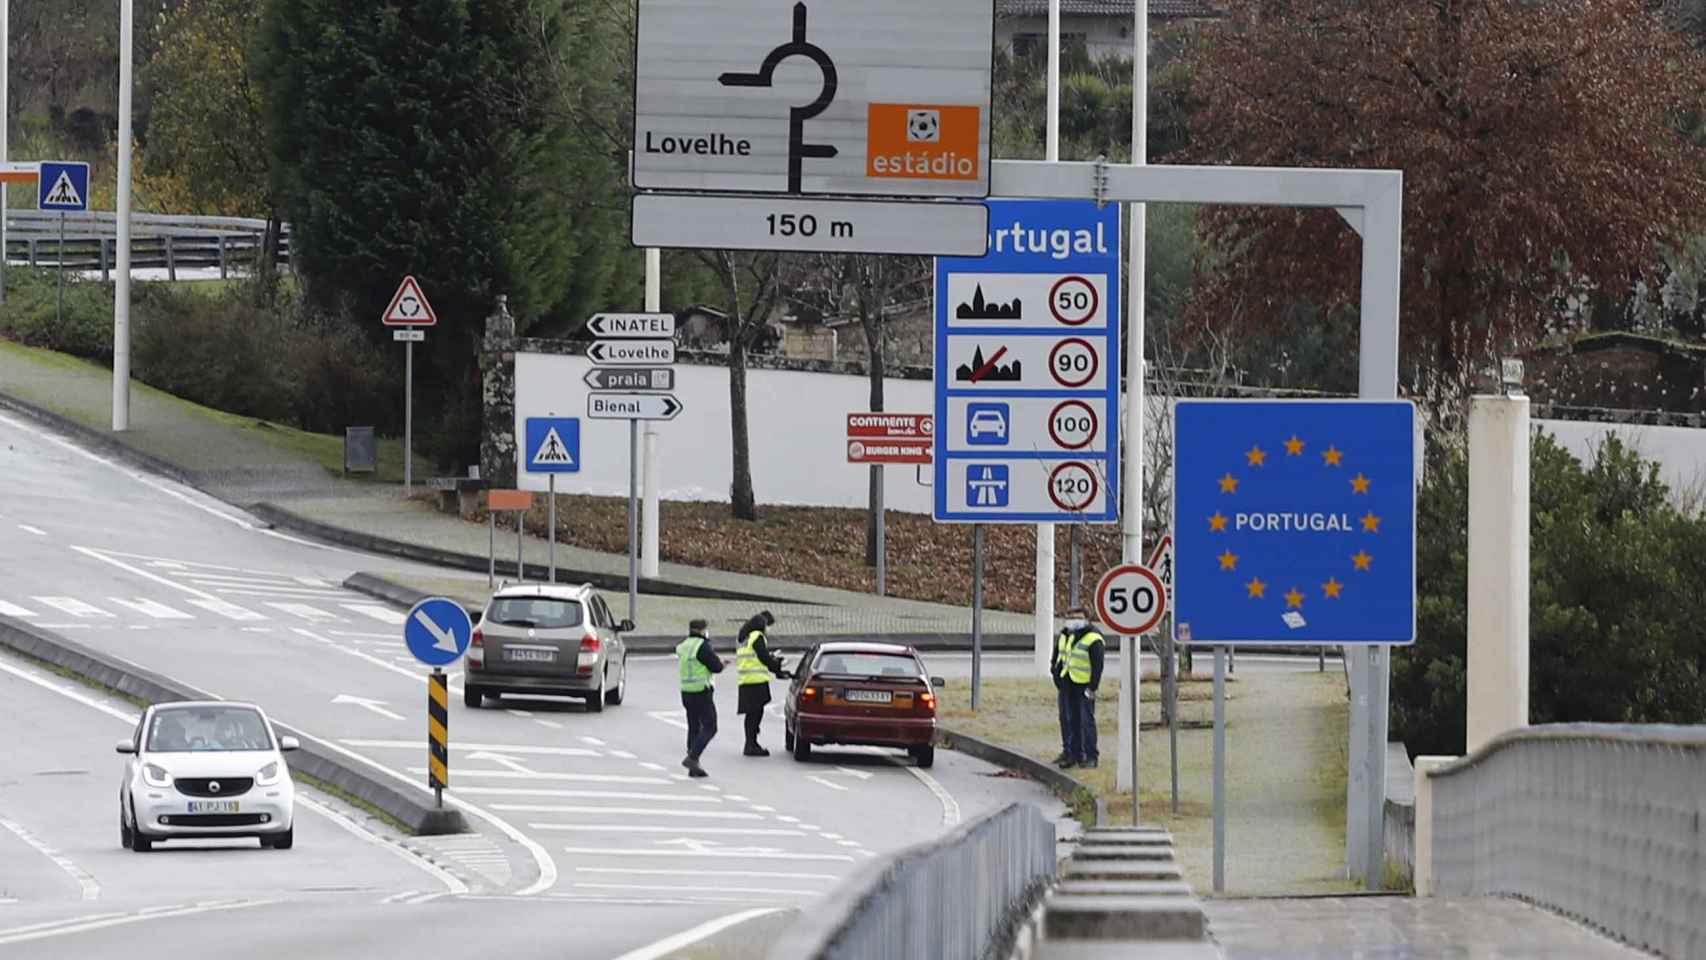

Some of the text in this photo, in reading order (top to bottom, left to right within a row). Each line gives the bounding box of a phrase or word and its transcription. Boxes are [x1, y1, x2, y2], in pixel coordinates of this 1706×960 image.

[646, 131, 751, 156] Lovelhe
[873, 151, 973, 175] estádio
[766, 213, 854, 238] 150 m
[988, 221, 1107, 259] rtugal
[1059, 292, 1088, 310] 50
[610, 319, 670, 331] INATEL
[609, 346, 669, 358] Lovelhe
[1058, 354, 1088, 372] 90
[608, 373, 647, 387] praia
[594, 399, 640, 412] Bienal
[1056, 417, 1090, 432] 100
[1056, 478, 1089, 494] 120
[1236, 513, 1353, 531] PORTUGAL
[1109, 587, 1154, 614] 50
